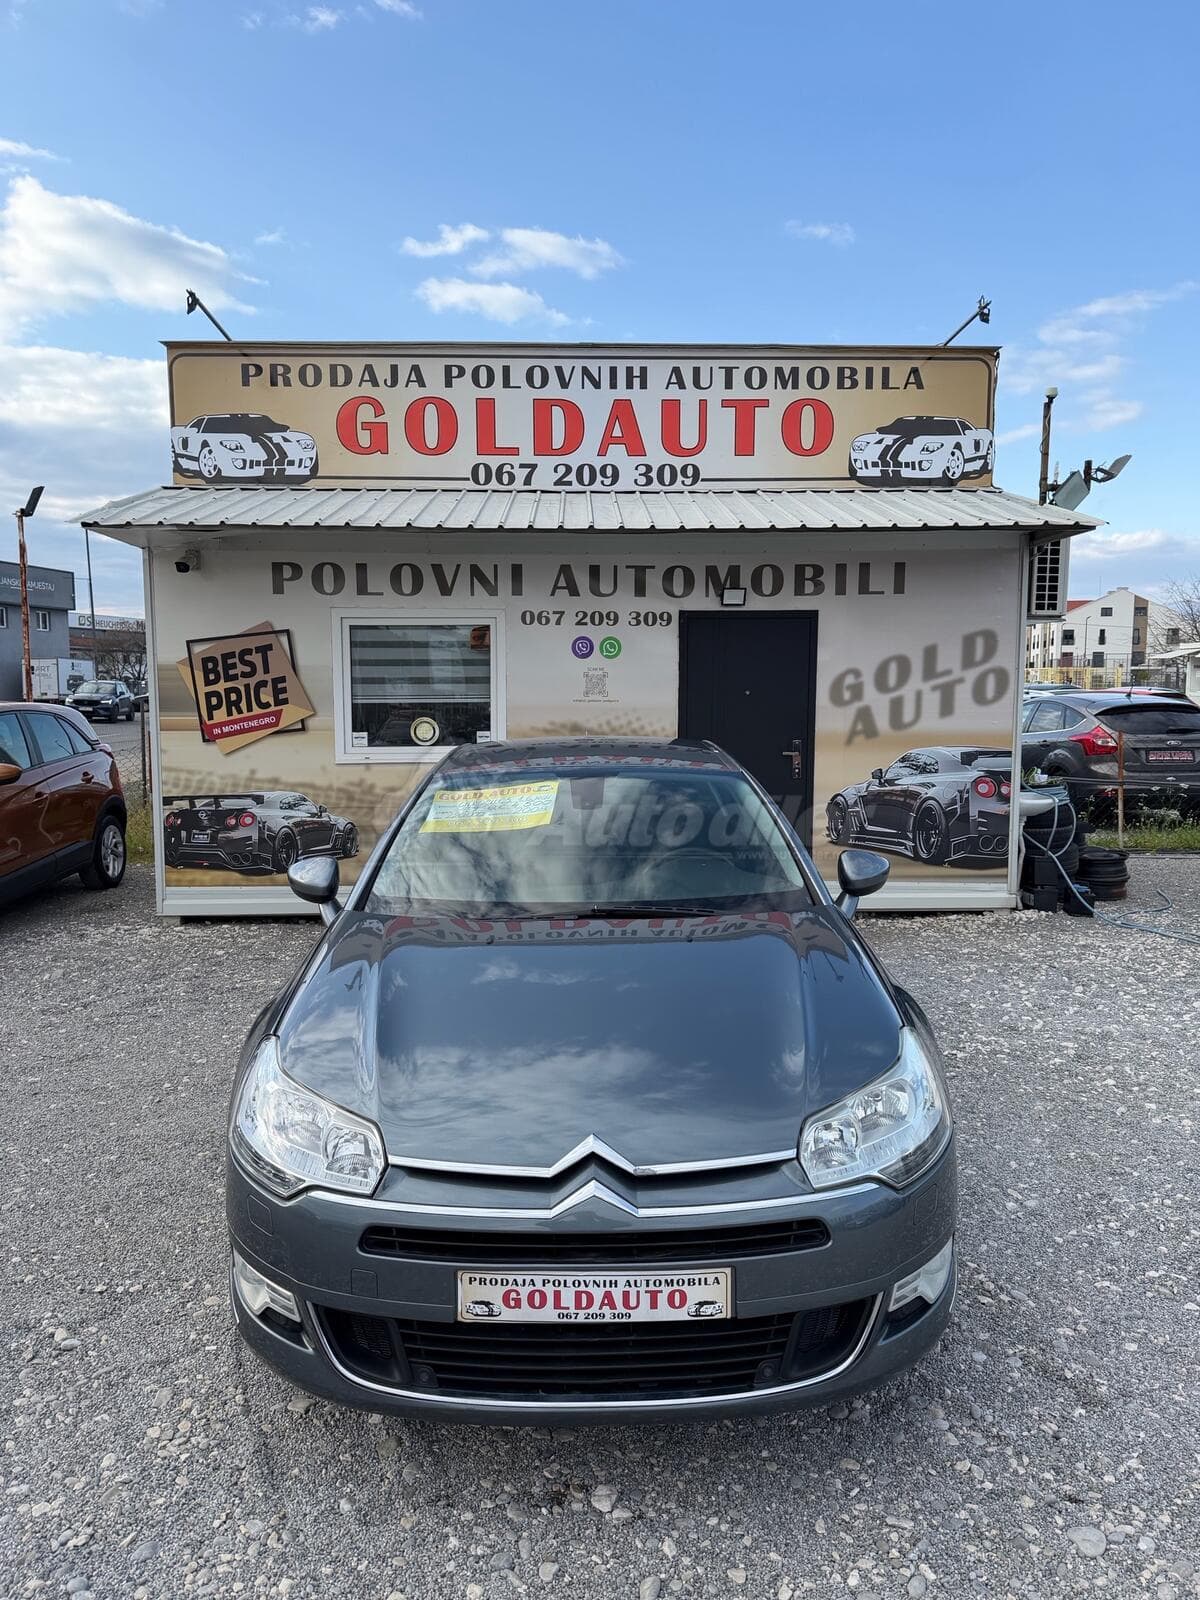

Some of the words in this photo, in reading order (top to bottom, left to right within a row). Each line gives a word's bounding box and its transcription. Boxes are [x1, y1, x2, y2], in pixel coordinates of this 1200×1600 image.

[240, 362, 427, 389] PRODAJA
[444, 363, 648, 390] POLOVNIH
[665, 365, 925, 391] AUTOMOBILA
[335, 395, 835, 457] GOLDAUTO
[470, 462, 539, 487] 067
[553, 463, 620, 487] 209
[634, 463, 701, 487] 309
[271, 561, 523, 597] POLOVNI
[550, 561, 907, 598] AUTOMOBILI
[520, 610, 565, 626] 067
[574, 610, 620, 627] 209
[628, 610, 673, 627] 309
[201, 643, 273, 687] BEST
[829, 628, 999, 708] GOLD
[204, 675, 289, 721] PRICE
[845, 665, 1010, 746] AUTO
[213, 727, 221, 735] IN
[222, 716, 276, 732] MONTENEGRO
[439, 791, 483, 801] GOLD
[468, 1276, 537, 1288] PRODAJA
[542, 1278, 618, 1289] POLOVNIH
[624, 1276, 721, 1288] AUTOMOBILA
[501, 1288, 688, 1311] GOLDAUTO
[557, 1311, 580, 1320] 067
[583, 1311, 606, 1320] 209
[609, 1311, 632, 1320] 309
